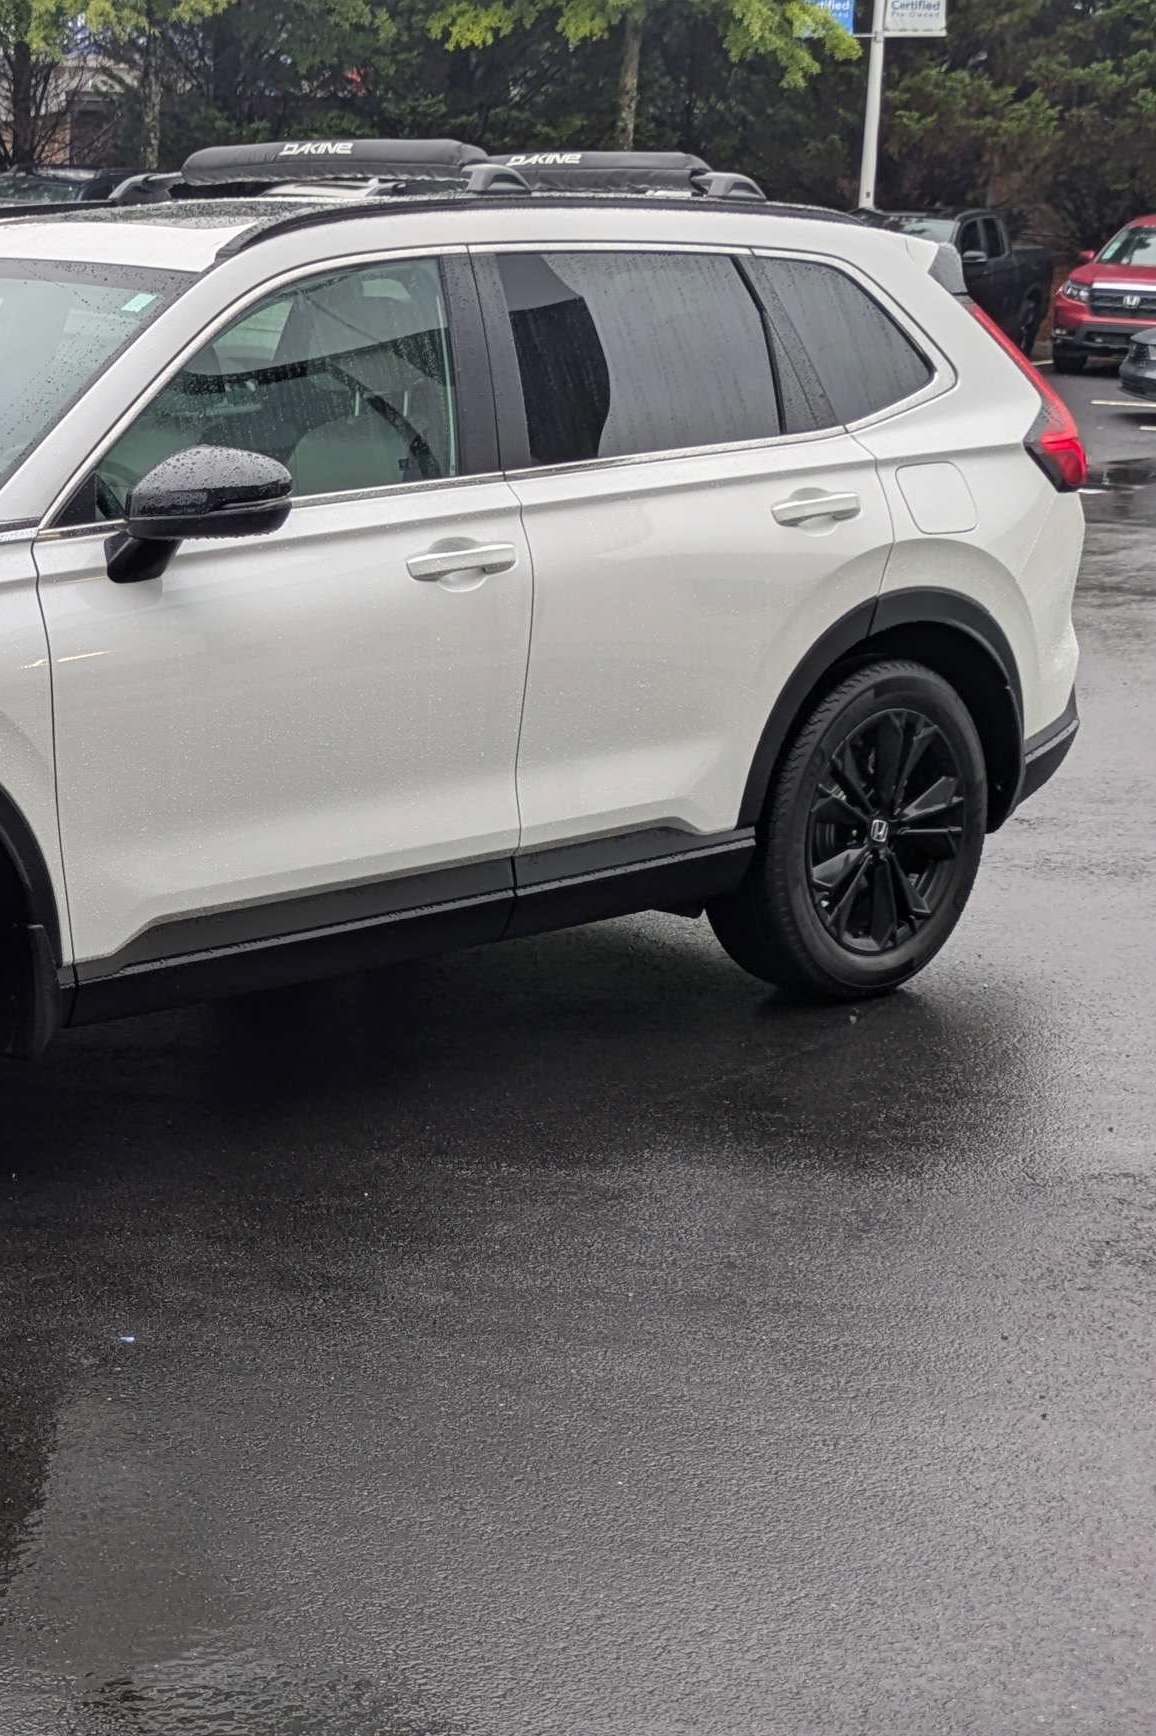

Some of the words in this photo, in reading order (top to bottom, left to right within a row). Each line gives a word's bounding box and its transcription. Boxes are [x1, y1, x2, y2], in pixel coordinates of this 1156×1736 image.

[891, 0, 941, 11] Certified
[279, 142, 353, 156] DAKINE
[506, 152, 582, 167] DAKINE
